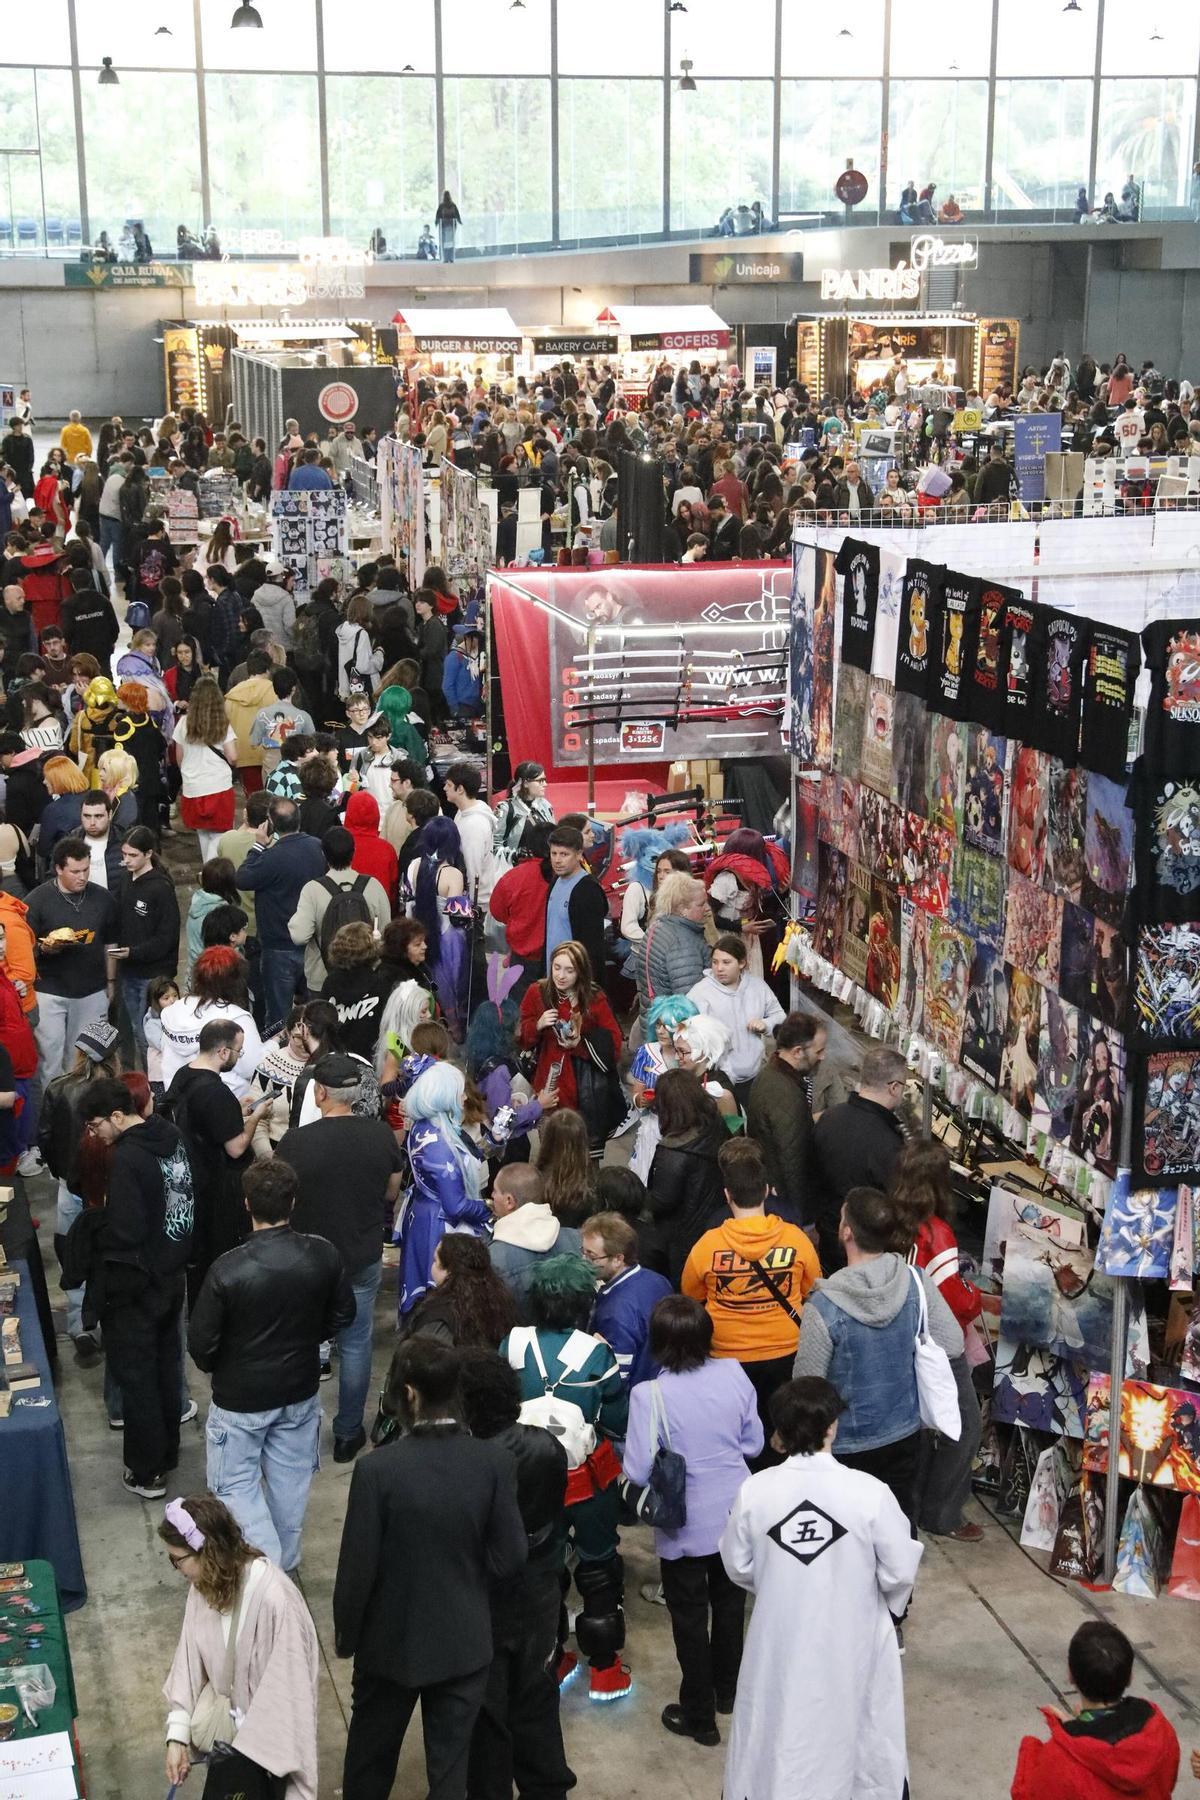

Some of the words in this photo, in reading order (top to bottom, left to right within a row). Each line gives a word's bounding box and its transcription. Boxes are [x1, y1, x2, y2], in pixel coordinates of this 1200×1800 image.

[913, 235, 977, 270] Pizza
[111, 266, 137, 276] CAJA
[138, 266, 173, 276] RURAL
[736, 263, 780, 278] Unicaja
[307, 284, 364, 298] LOVERS
[421, 340, 461, 350] BURGER
[464, 340, 470, 350] &
[473, 341, 494, 350] HOT
[496, 341, 518, 351] DOG
[545, 342, 581, 352] BAKERY
[583, 341, 608, 351] CAFÉ
[664, 333, 718, 348] GOFERS
[1122, 424, 1137, 437] 60
[1170, 705, 1200, 721] SILKSO
[791, 1520, 825, 1544] 五
